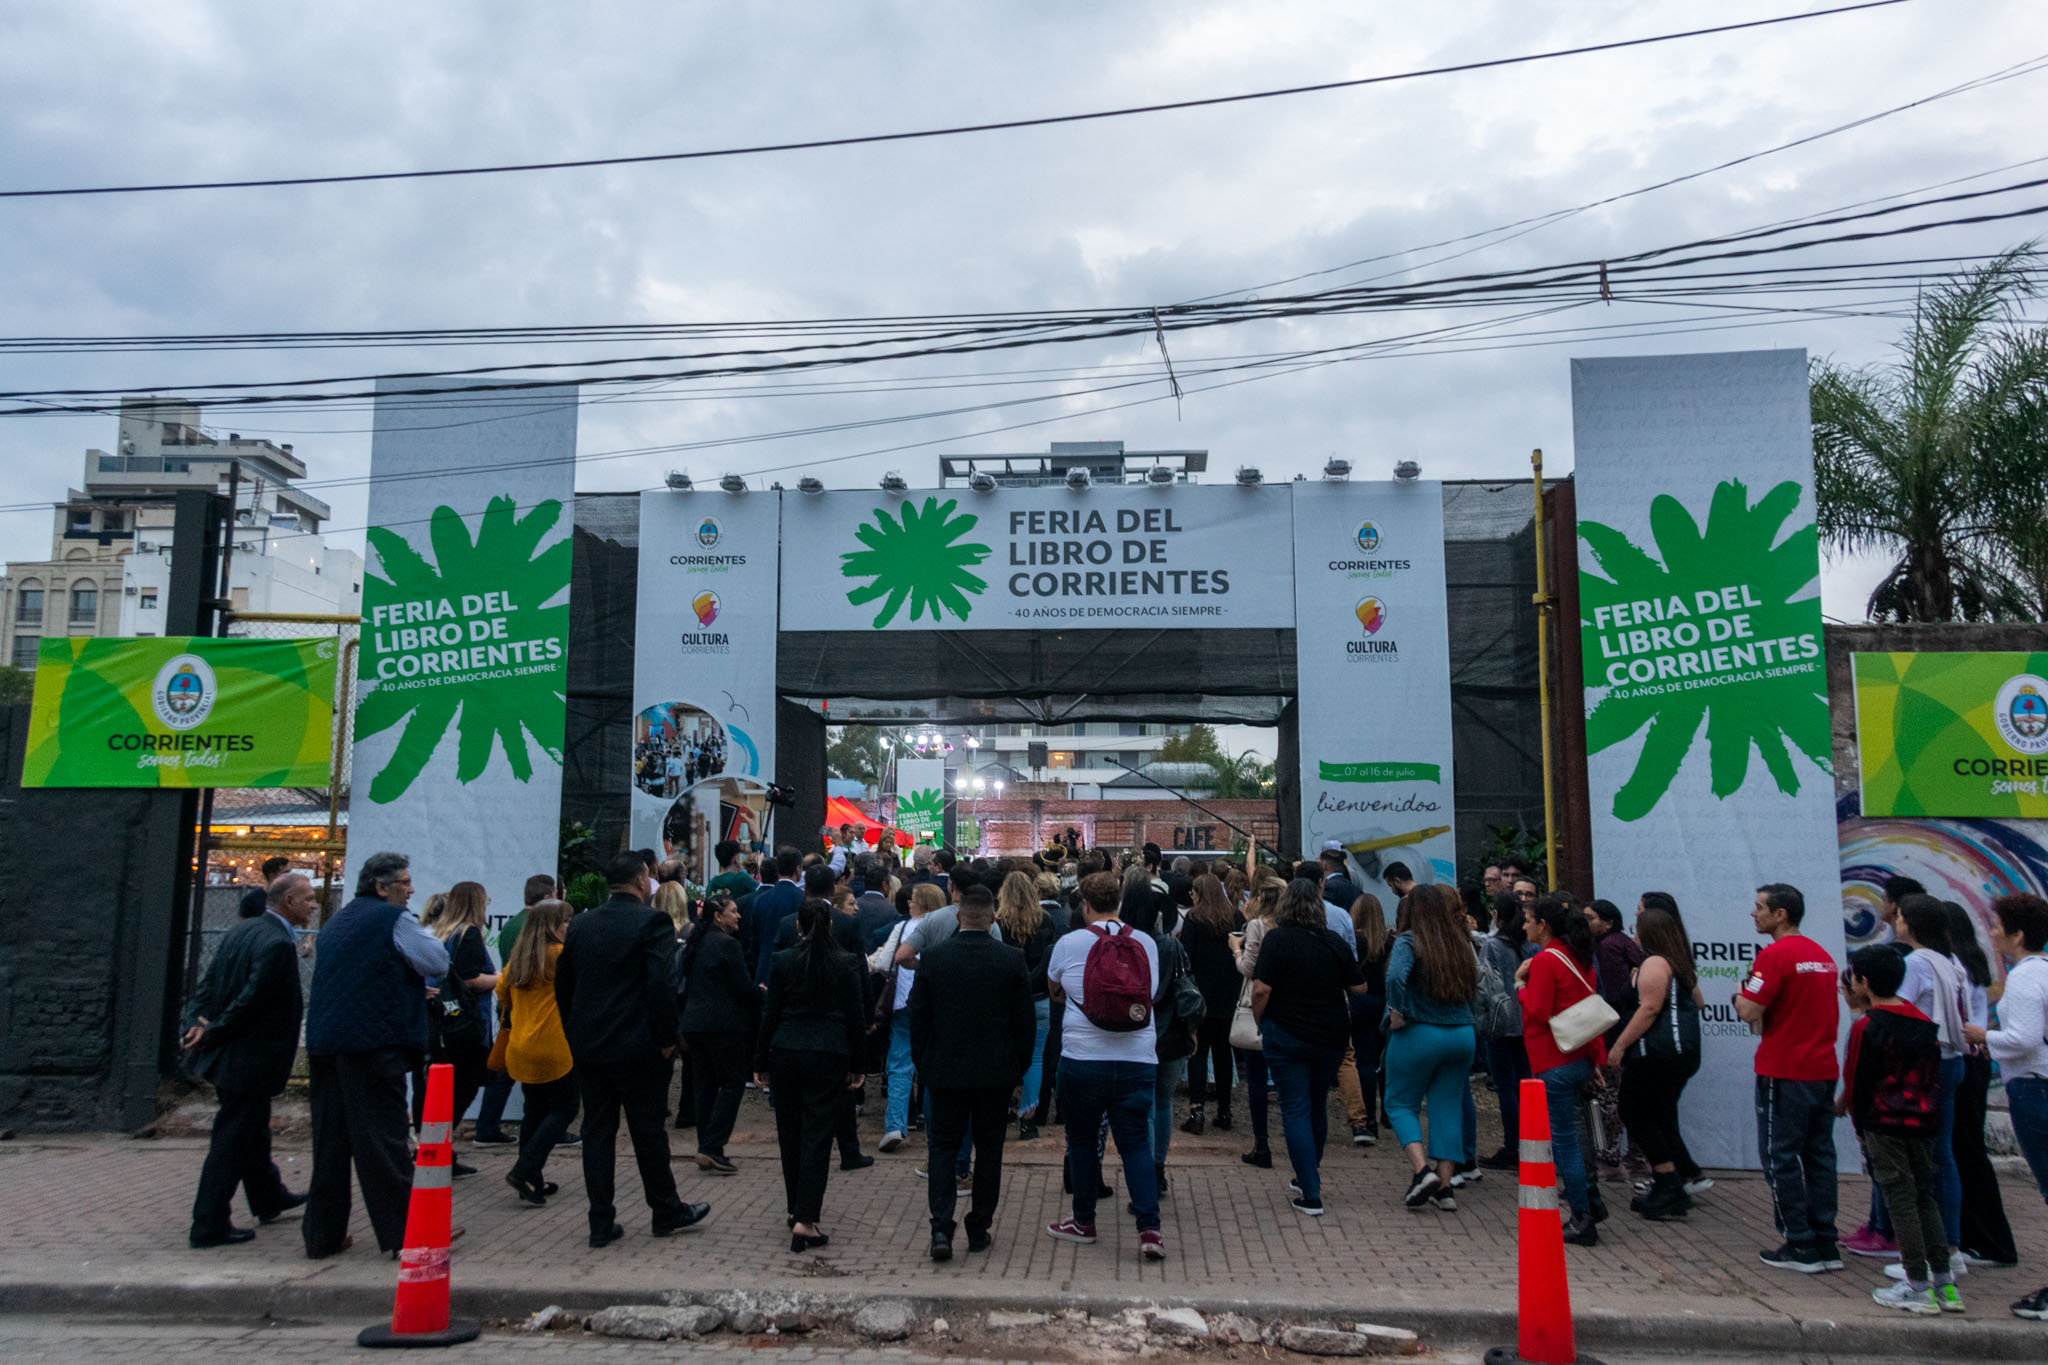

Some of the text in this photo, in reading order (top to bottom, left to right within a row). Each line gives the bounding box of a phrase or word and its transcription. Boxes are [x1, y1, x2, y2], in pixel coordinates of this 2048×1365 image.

[1010, 508, 1182, 534] FERIA DEL
[670, 555, 746, 565] CORRIENTES
[1010, 540, 1167, 565] LIBRO DE
[1329, 560, 1411, 570] CORRIENTES
[1009, 570, 1230, 597] CORRIENTES
[373, 591, 518, 627] FERIA DEL
[1033, 606, 1067, 618] AÑOS
[1070, 608, 1085, 617] DE
[1088, 606, 1169, 617] DEMOCRACIA
[1594, 585, 1761, 630] FERIA DEL
[375, 617, 508, 653] LIBRO DE
[682, 633, 729, 645] CULTURA
[1600, 614, 1753, 658] LIBRO DE
[681, 646, 730, 655] CORRIENTES
[1347, 641, 1397, 653] CULTURA
[377, 637, 562, 679] CORRIENTES
[1346, 654, 1399, 663] CORRIENTES
[1606, 634, 1819, 686] CORRIENTES
[397, 679, 426, 690] AÑOS
[428, 678, 442, 686] DE
[444, 667, 512, 685] DEMOCRACIA
[1632, 683, 1665, 698] AÑOS
[1667, 682, 1682, 693] DE
[1684, 671, 1763, 690] DEMOCRACIA
[108, 734, 254, 751] CORRIENTES
[137, 753, 181, 770] somos
[1954, 758, 2048, 776] CORRIE
[1345, 767, 1415, 778] 07 al 16 de julio
[1991, 780, 2038, 796] somos
[1317, 791, 1441, 812] bienvenidos
